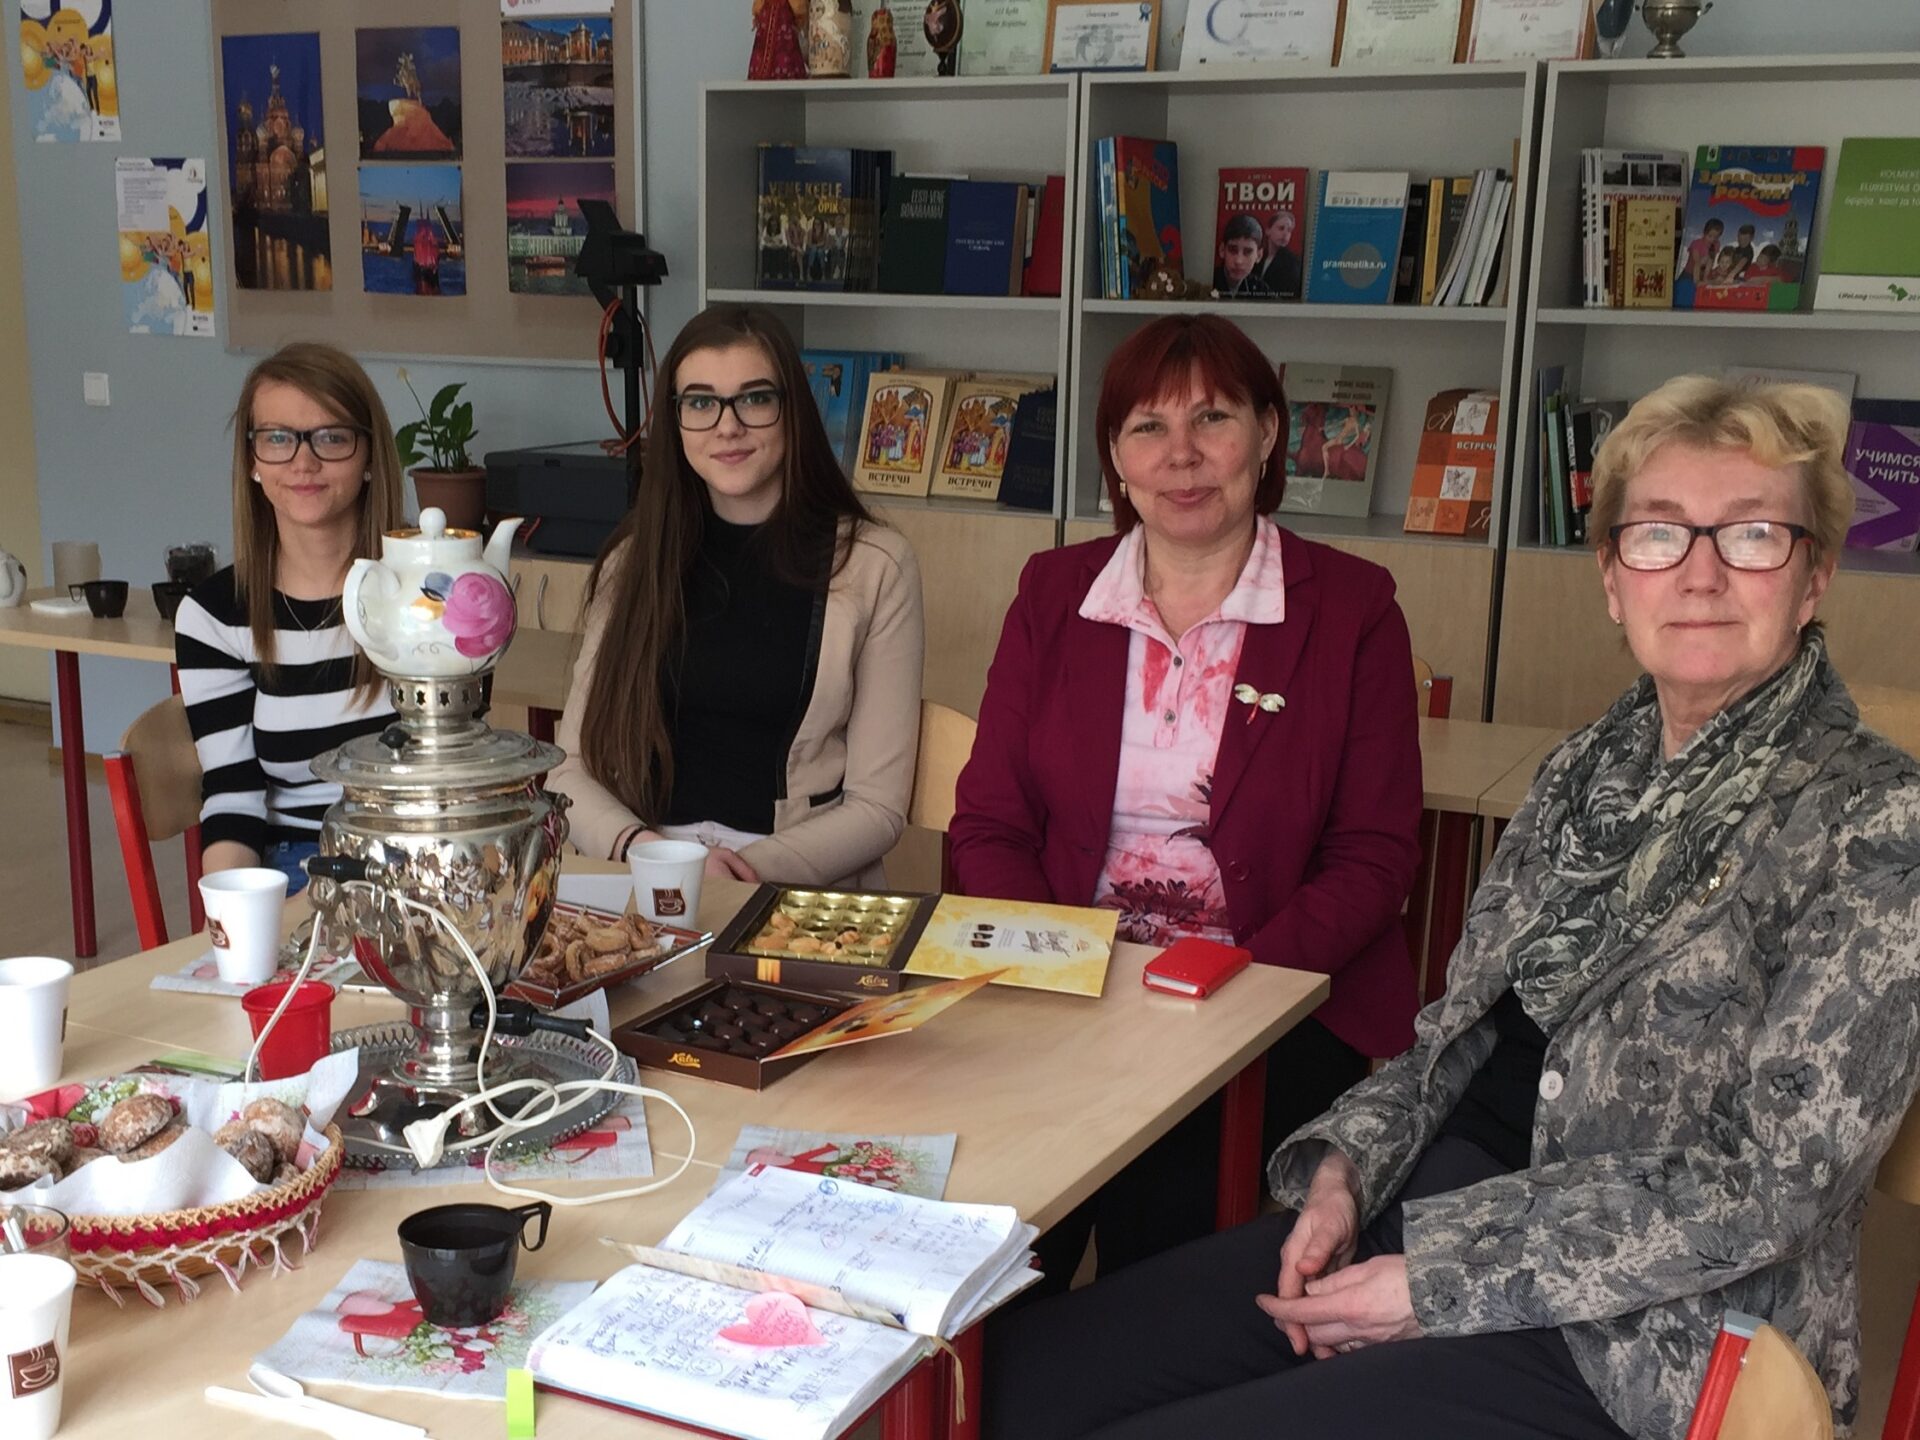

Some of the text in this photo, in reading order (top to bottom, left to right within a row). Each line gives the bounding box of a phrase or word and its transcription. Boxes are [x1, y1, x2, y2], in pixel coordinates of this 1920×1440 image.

[1224, 178, 1295, 202] ТВОЙ
[1322, 259, 1387, 270] grammatika.ru
[868, 472, 911, 484] ВСТРЕЧИ
[1868, 466, 1920, 485] УЧИТЬ
[948, 477, 992, 489] ВСТРЕЧИ
[854, 974, 889, 988] Kalev
[666, 1051, 702, 1069] Kalev
